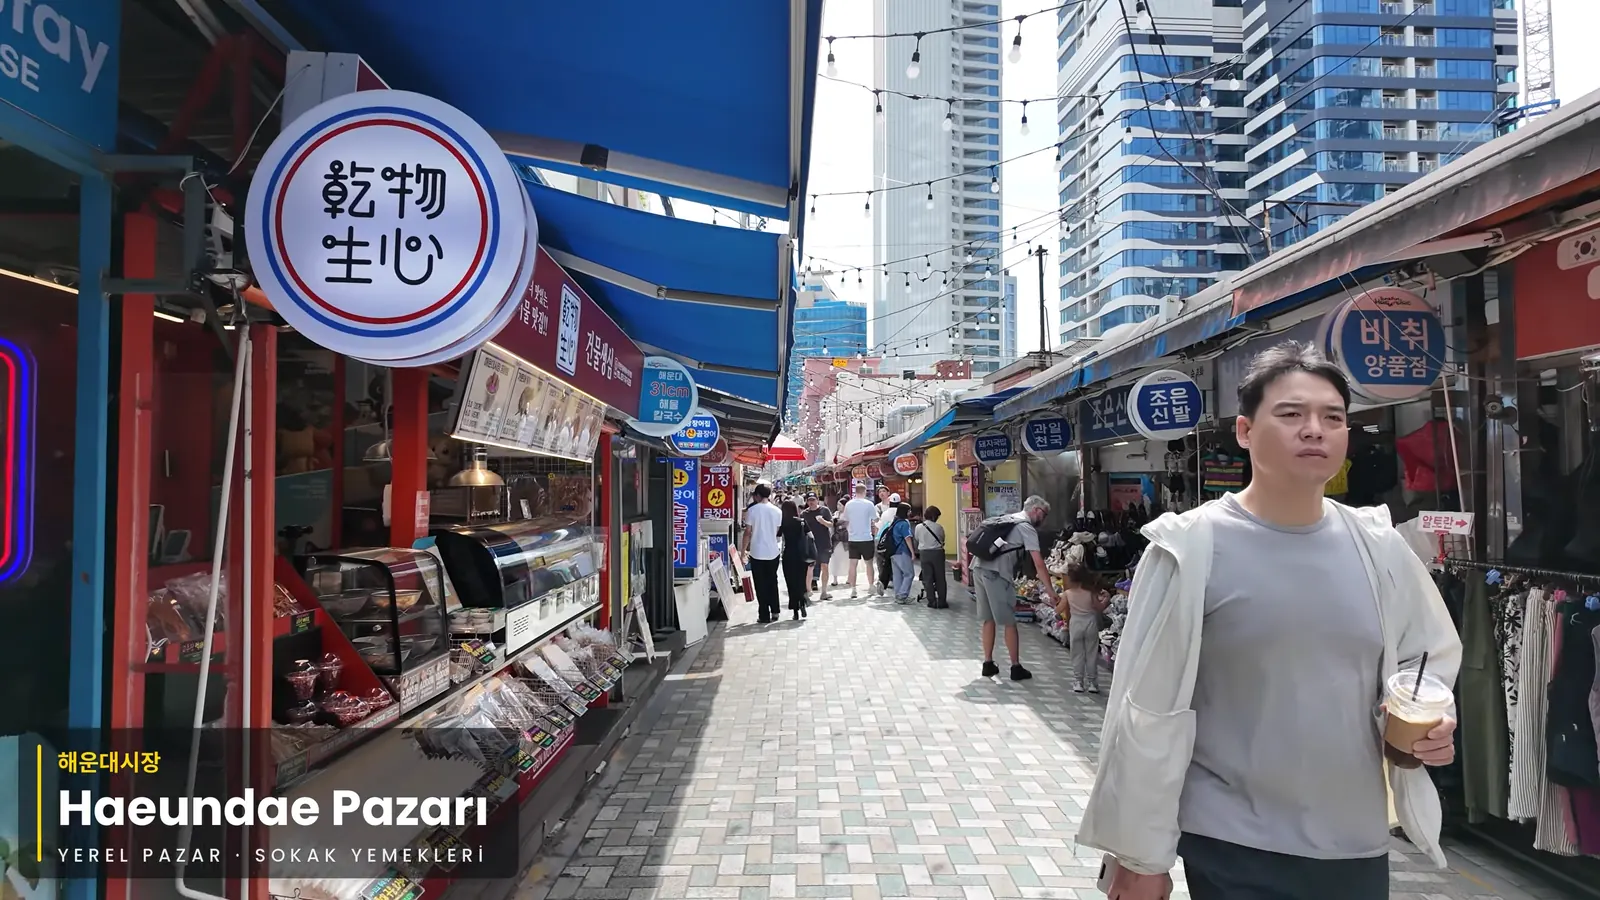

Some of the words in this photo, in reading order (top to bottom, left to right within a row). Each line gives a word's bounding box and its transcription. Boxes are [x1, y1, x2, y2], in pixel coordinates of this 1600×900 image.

[322, 159, 447, 220] 乾物
[322, 225, 444, 286] 生心
[1360, 317, 1429, 351] 비취
[1364, 354, 1427, 379] 양품점
[658, 371, 683, 381] 해운대
[649, 381, 690, 398] 31cm
[1149, 387, 1189, 407] 조은
[659, 398, 679, 410] 해물
[653, 410, 683, 422] 칼국수
[1150, 404, 1191, 425] 신발
[1034, 422, 1061, 434] 과일
[1035, 434, 1062, 448] 천국
[703, 473, 731, 487] 기장
[674, 489, 695, 500] 장어
[1421, 515, 1455, 530] 알토란
